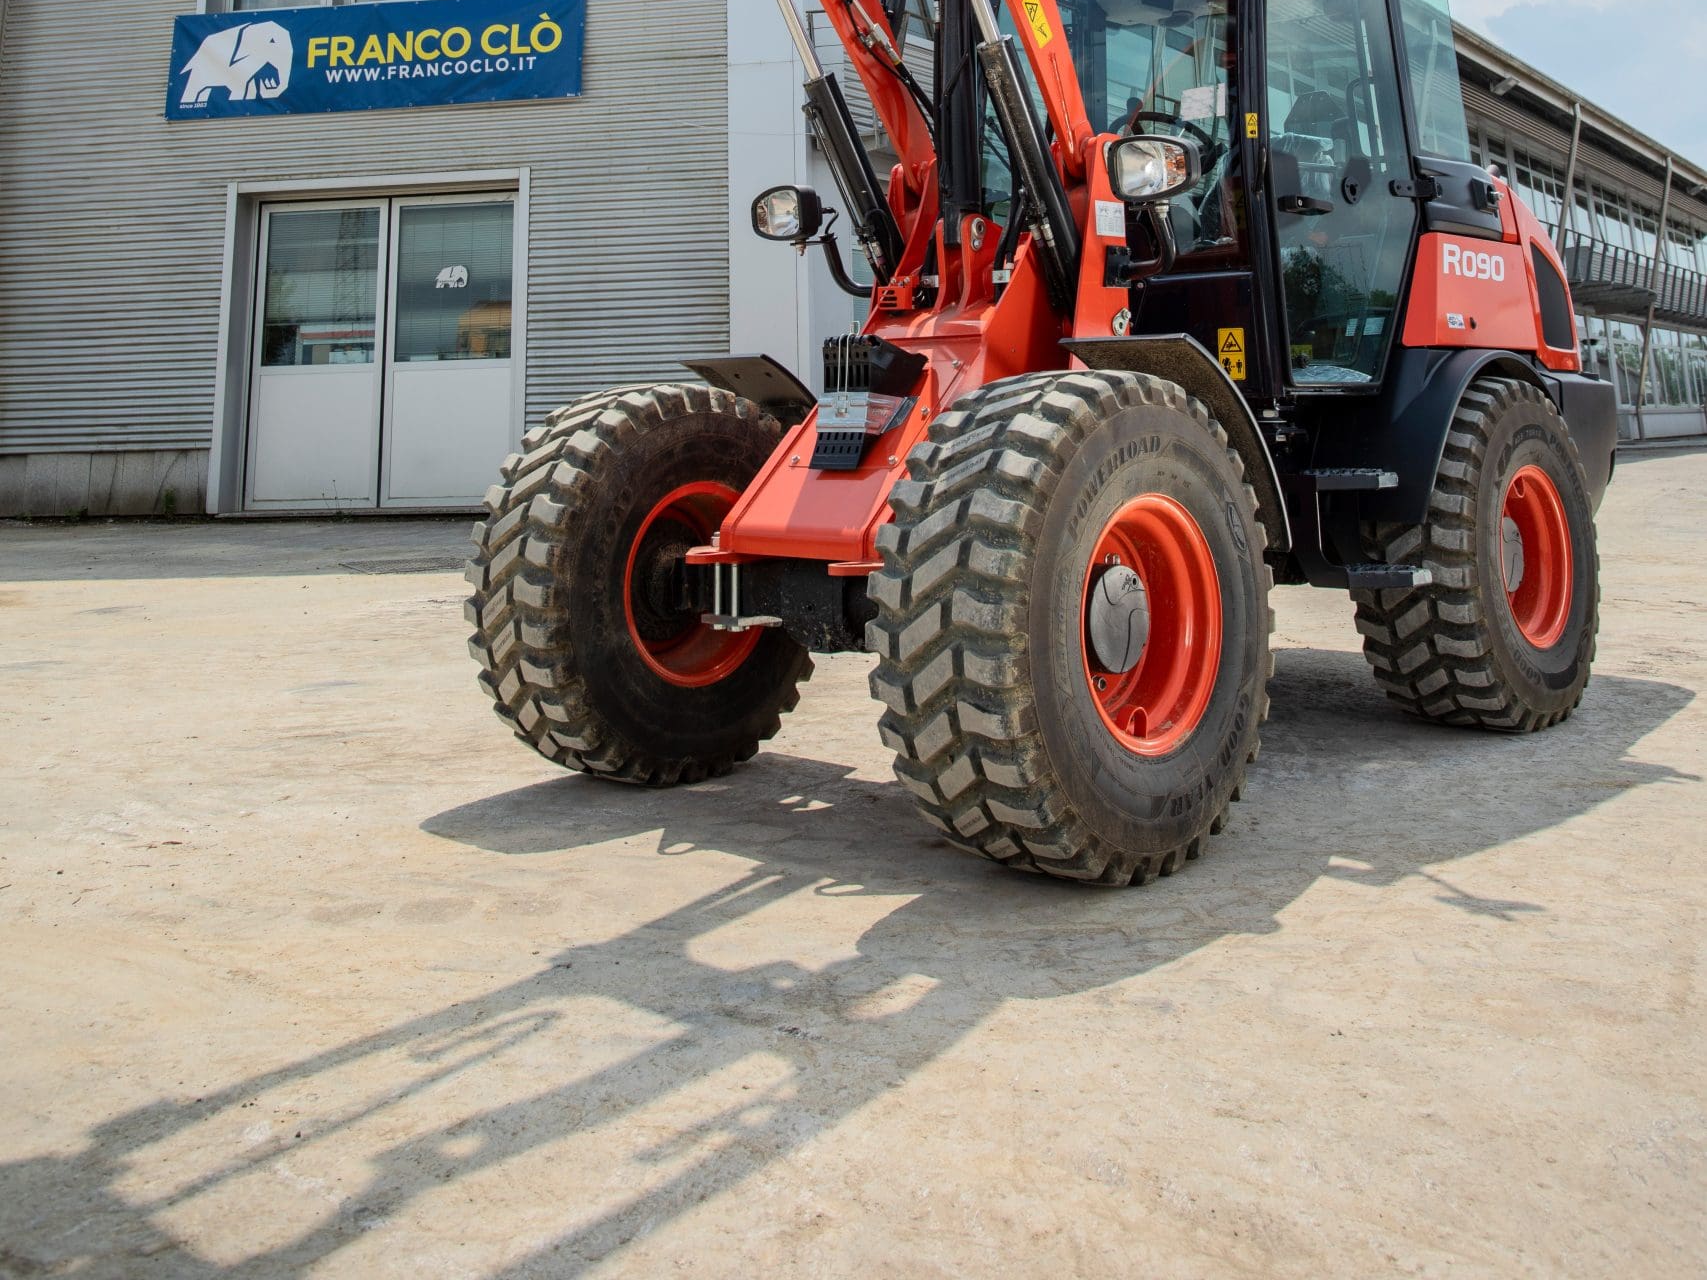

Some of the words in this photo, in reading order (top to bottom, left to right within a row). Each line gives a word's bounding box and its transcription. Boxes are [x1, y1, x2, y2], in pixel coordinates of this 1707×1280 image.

[307, 26, 472, 69] FRANCO
[480, 12, 563, 56] CLÒ
[325, 56, 537, 84] WWW.FRANCOCLO.IT
